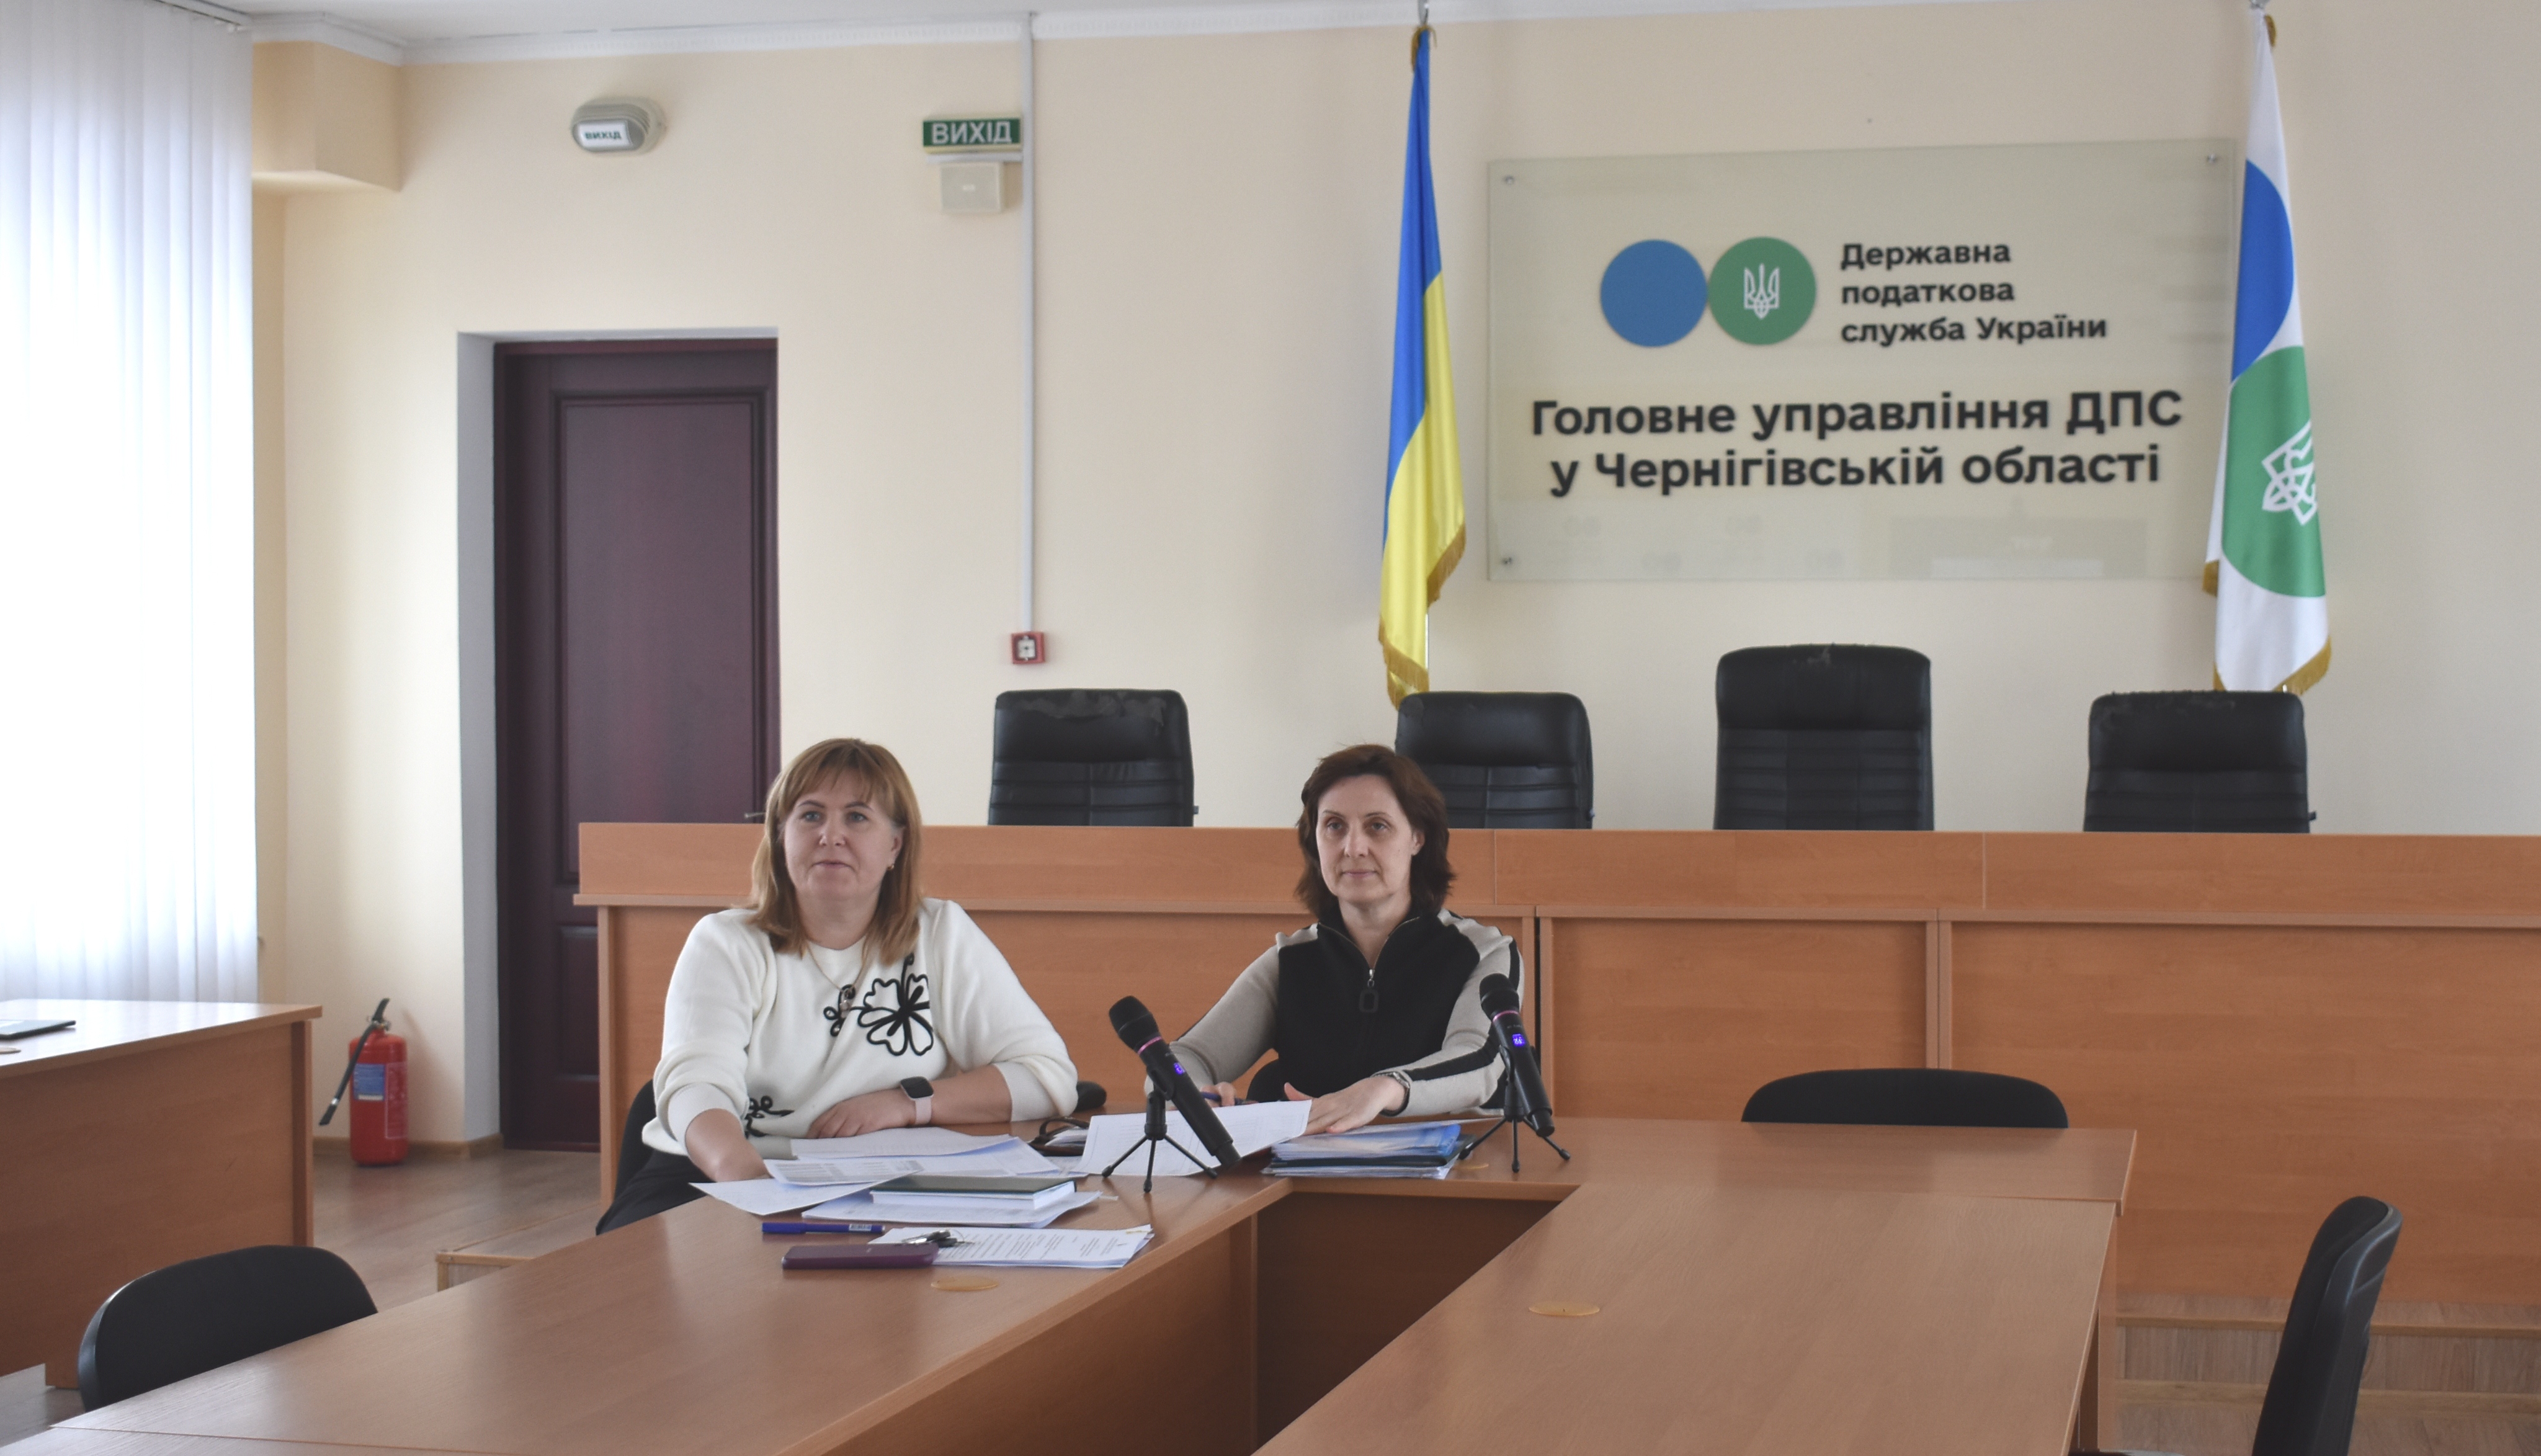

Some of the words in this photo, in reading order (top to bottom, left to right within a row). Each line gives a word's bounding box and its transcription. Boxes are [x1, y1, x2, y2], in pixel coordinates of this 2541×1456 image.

[932, 120, 1012, 145] ВИХІД
[1839, 243, 2012, 272] Державна
[1841, 281, 2016, 308] податкова
[1840, 316, 1967, 347] служба
[1975, 313, 2107, 347] України
[1532, 400, 1737, 437] Головне
[1751, 391, 2050, 442] управління
[2065, 389, 2183, 437] ДПС
[1549, 460, 1580, 499] у
[1594, 445, 1944, 497] Чернігівській
[1961, 442, 2159, 485] області
